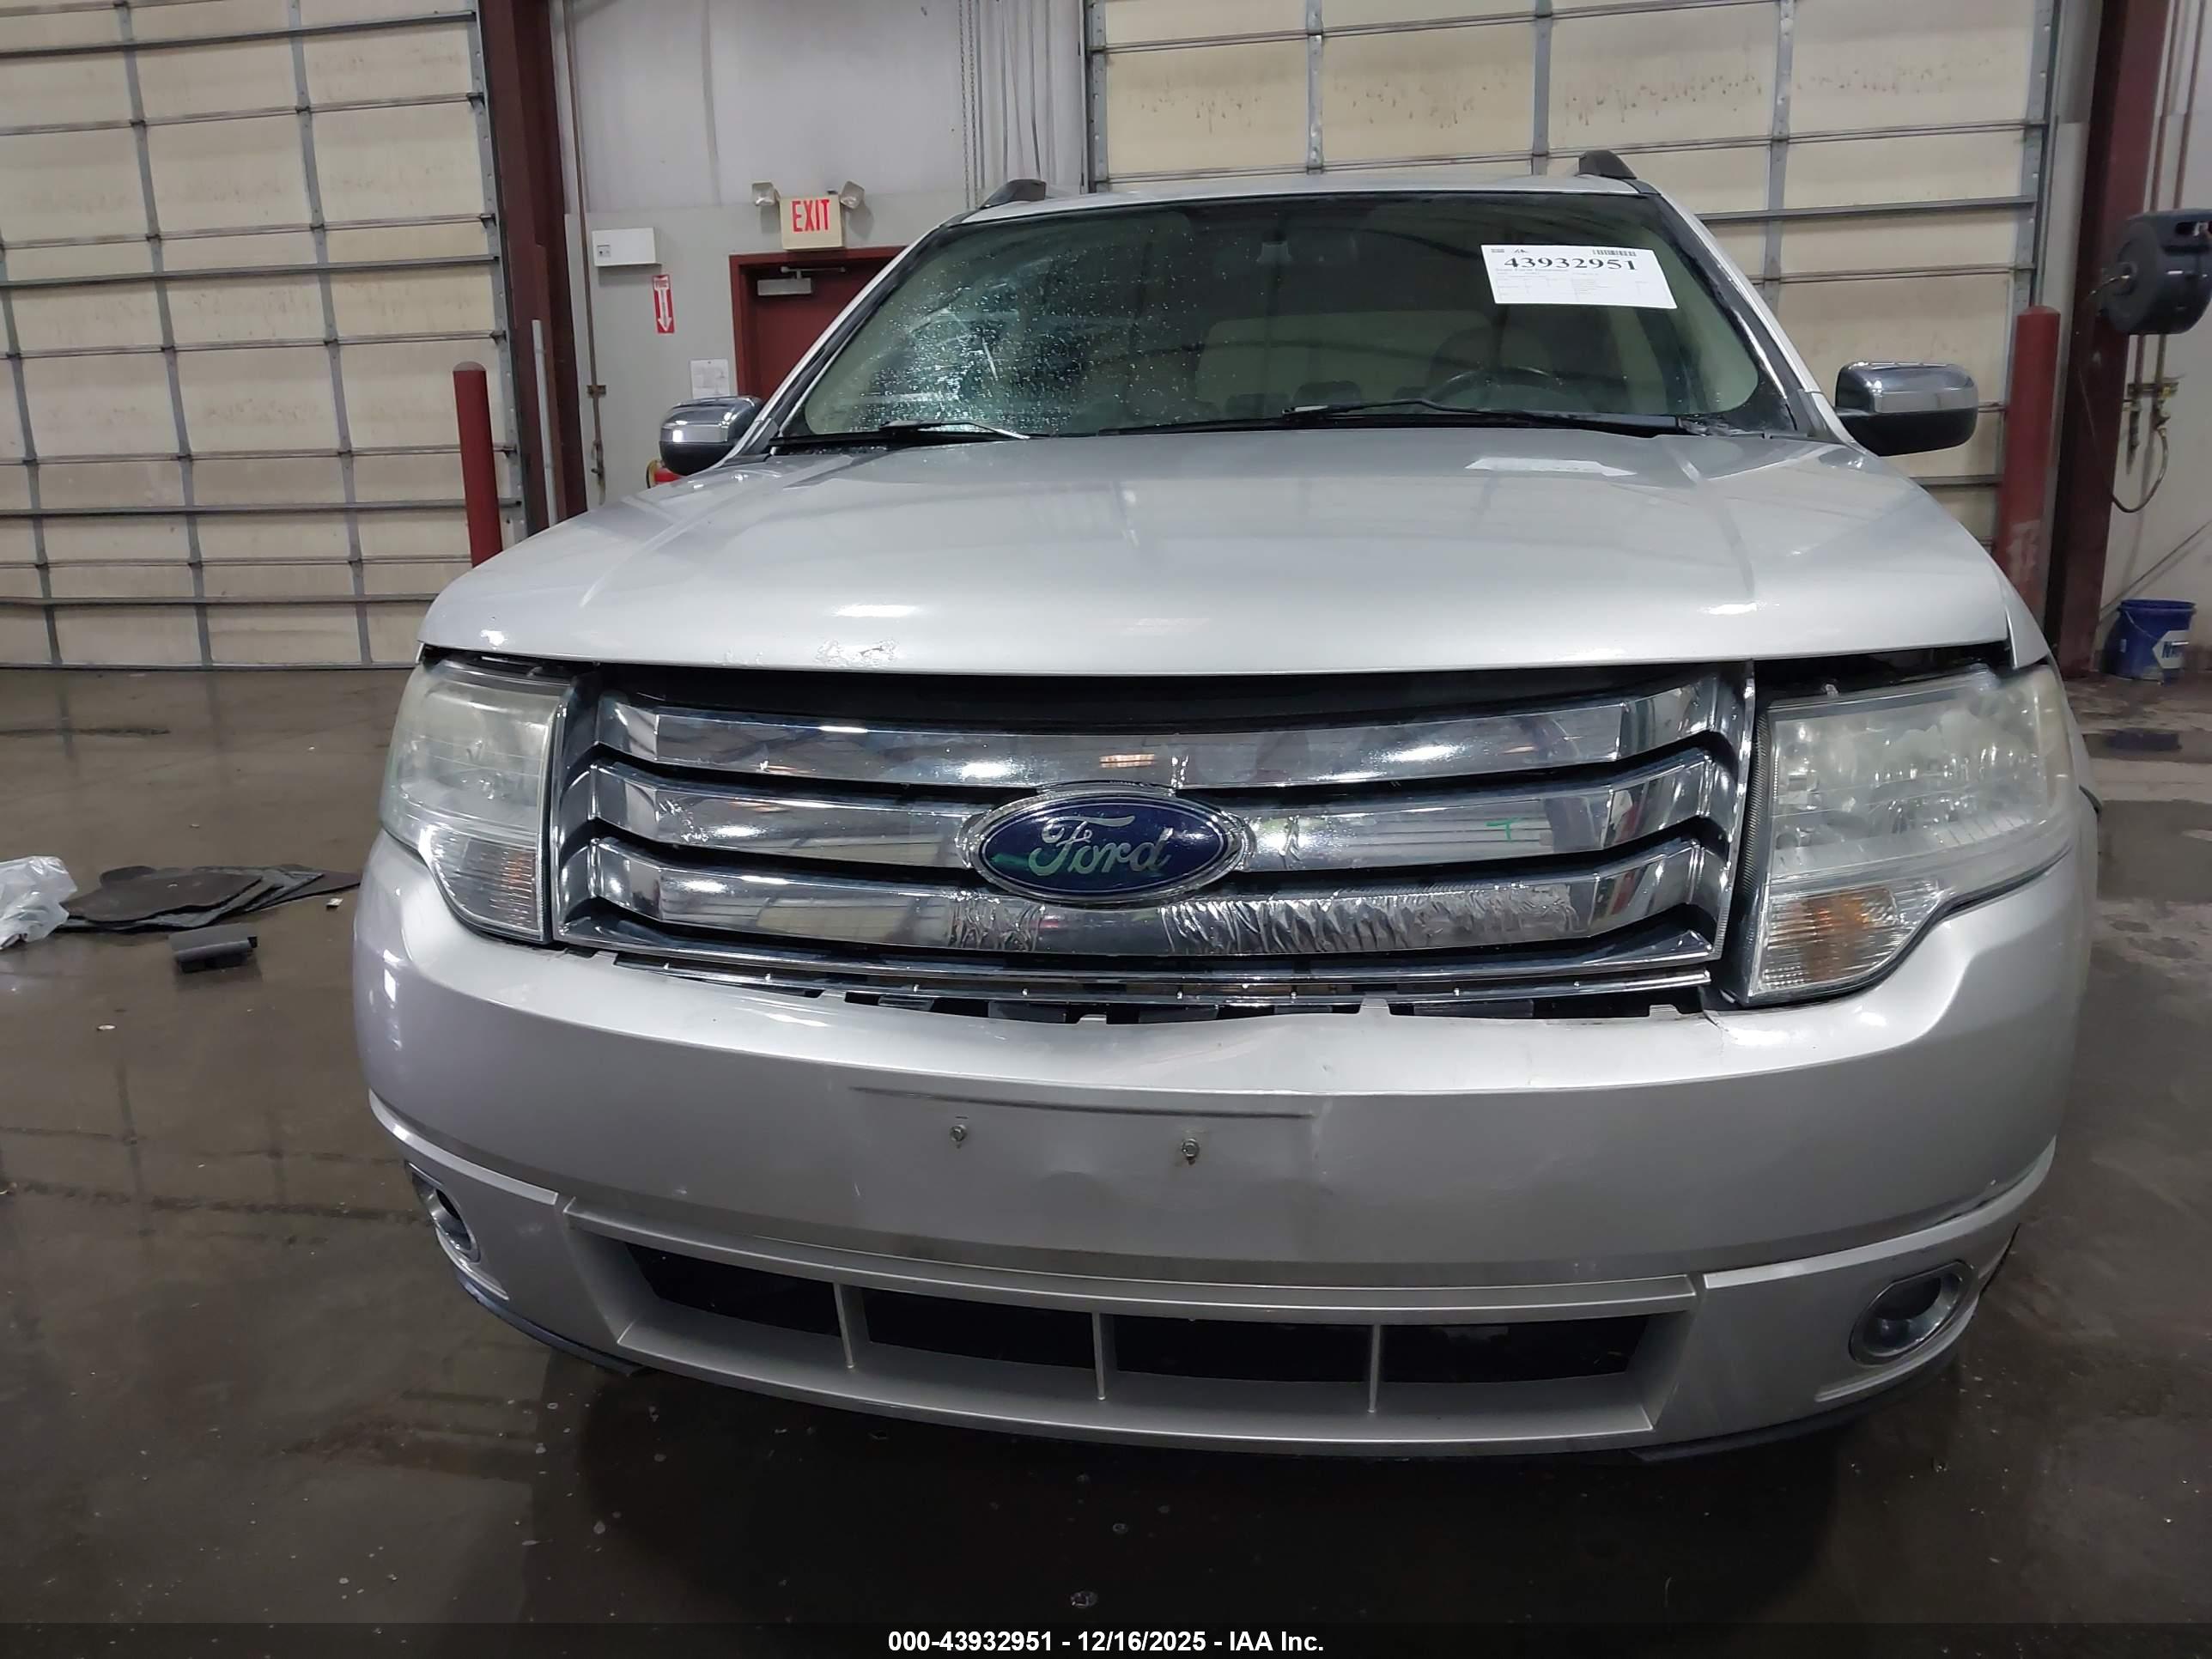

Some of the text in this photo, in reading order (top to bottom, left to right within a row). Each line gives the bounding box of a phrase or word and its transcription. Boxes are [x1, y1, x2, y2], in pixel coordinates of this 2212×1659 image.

[792, 198, 830, 233] EXIT
[1504, 257, 1637, 270] 43932951
[1028, 815, 1173, 876] Ford
